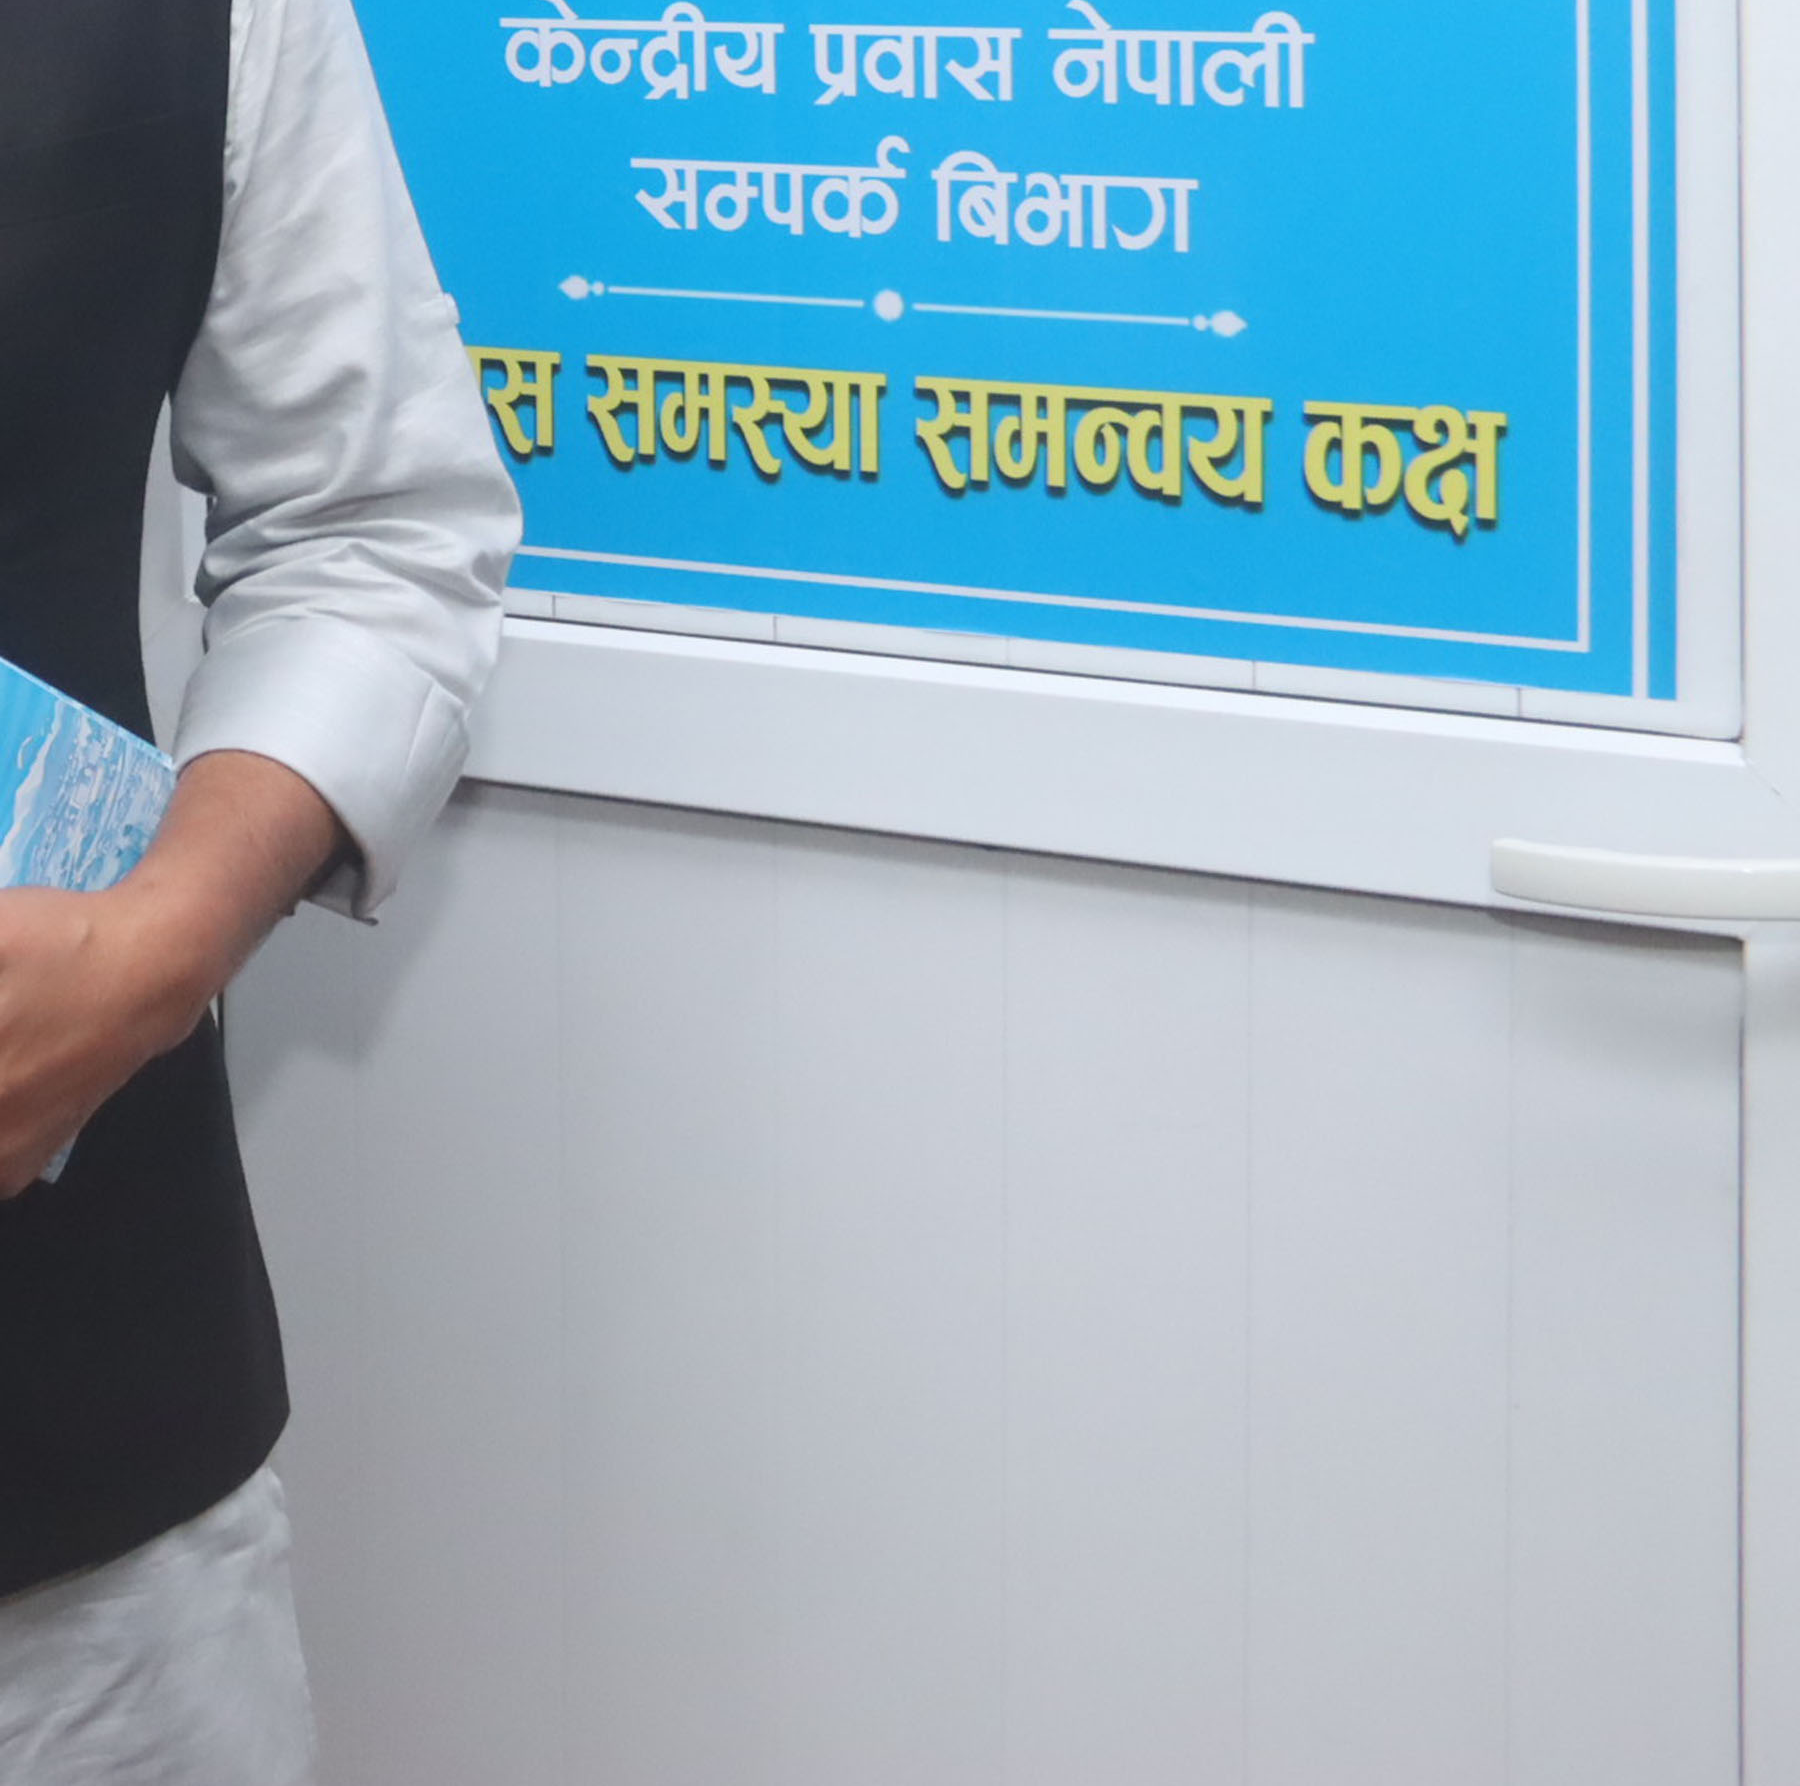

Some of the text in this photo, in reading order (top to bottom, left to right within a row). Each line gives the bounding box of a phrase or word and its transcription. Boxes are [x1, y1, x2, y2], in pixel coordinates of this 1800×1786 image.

[809, 24, 1022, 106] प्रवास
[631, 136, 1199, 252] सम्पर्क बिभाग
[464, 345, 1507, 534] स समस्या समन्वय कक्ष
